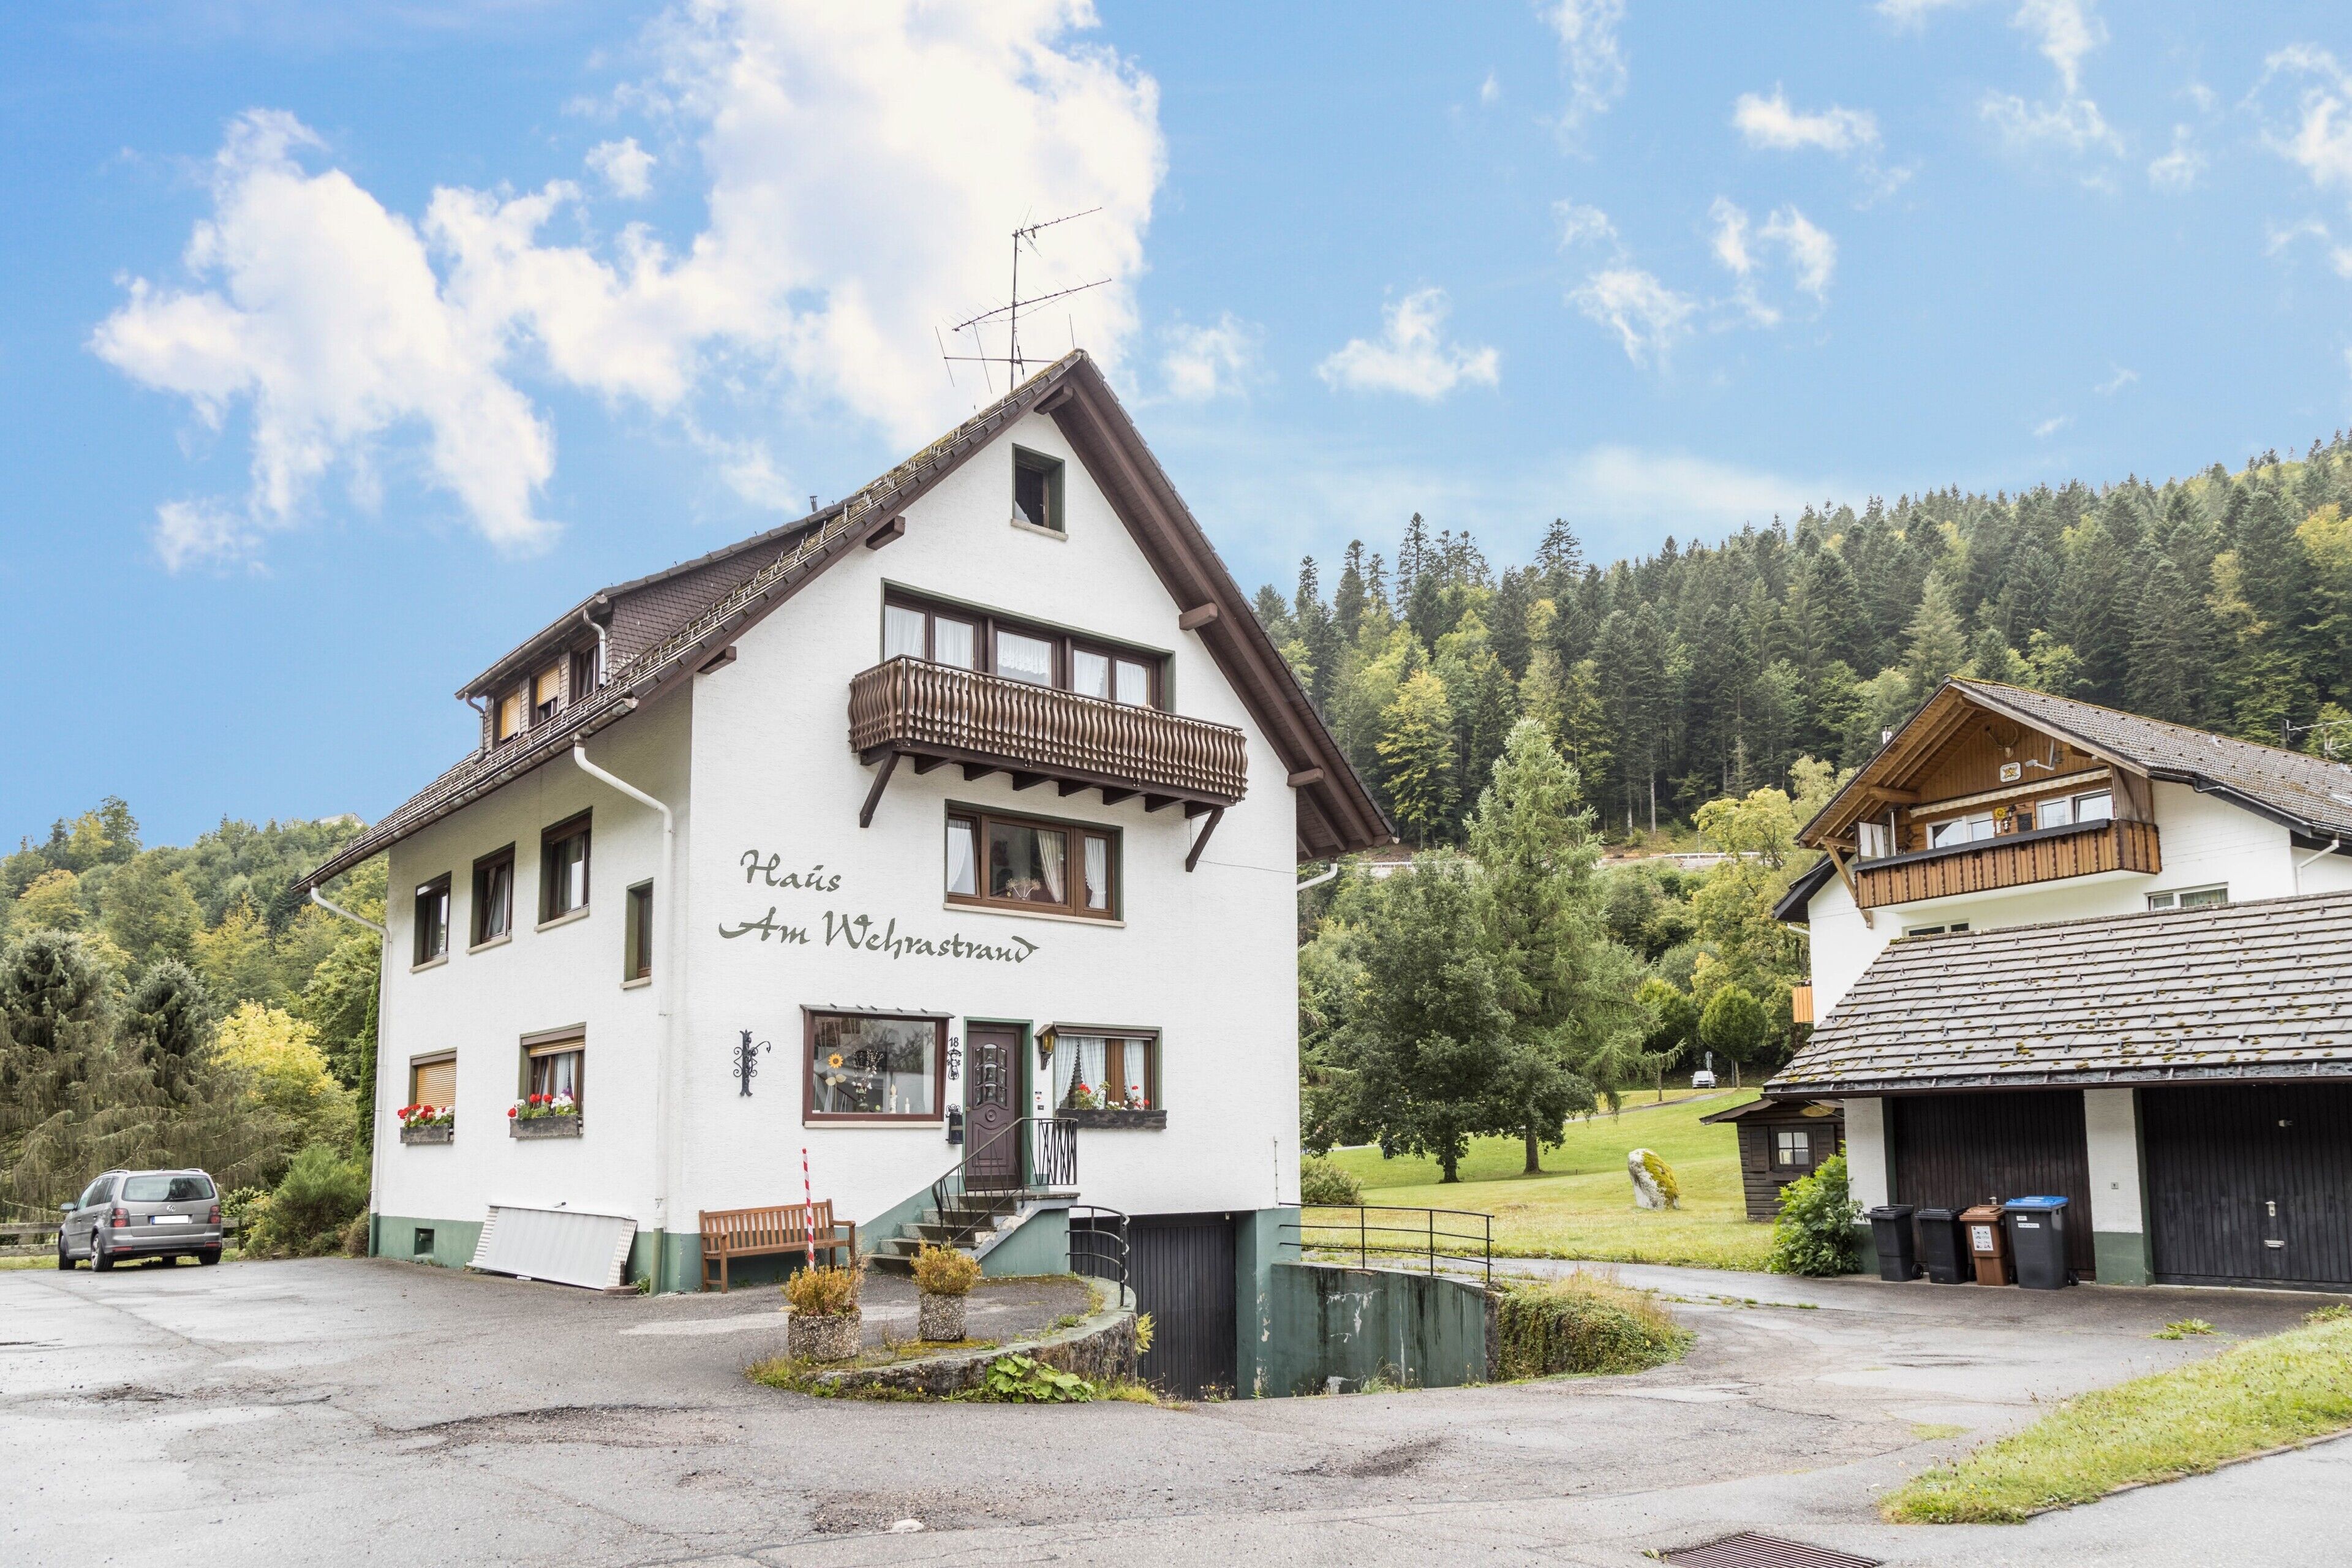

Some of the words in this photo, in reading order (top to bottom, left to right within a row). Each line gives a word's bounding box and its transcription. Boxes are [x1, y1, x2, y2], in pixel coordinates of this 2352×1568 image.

[718, 906, 810, 944] Am
[822, 910, 1040, 963] Wehrastrand
[949, 1036, 959, 1047] 18
